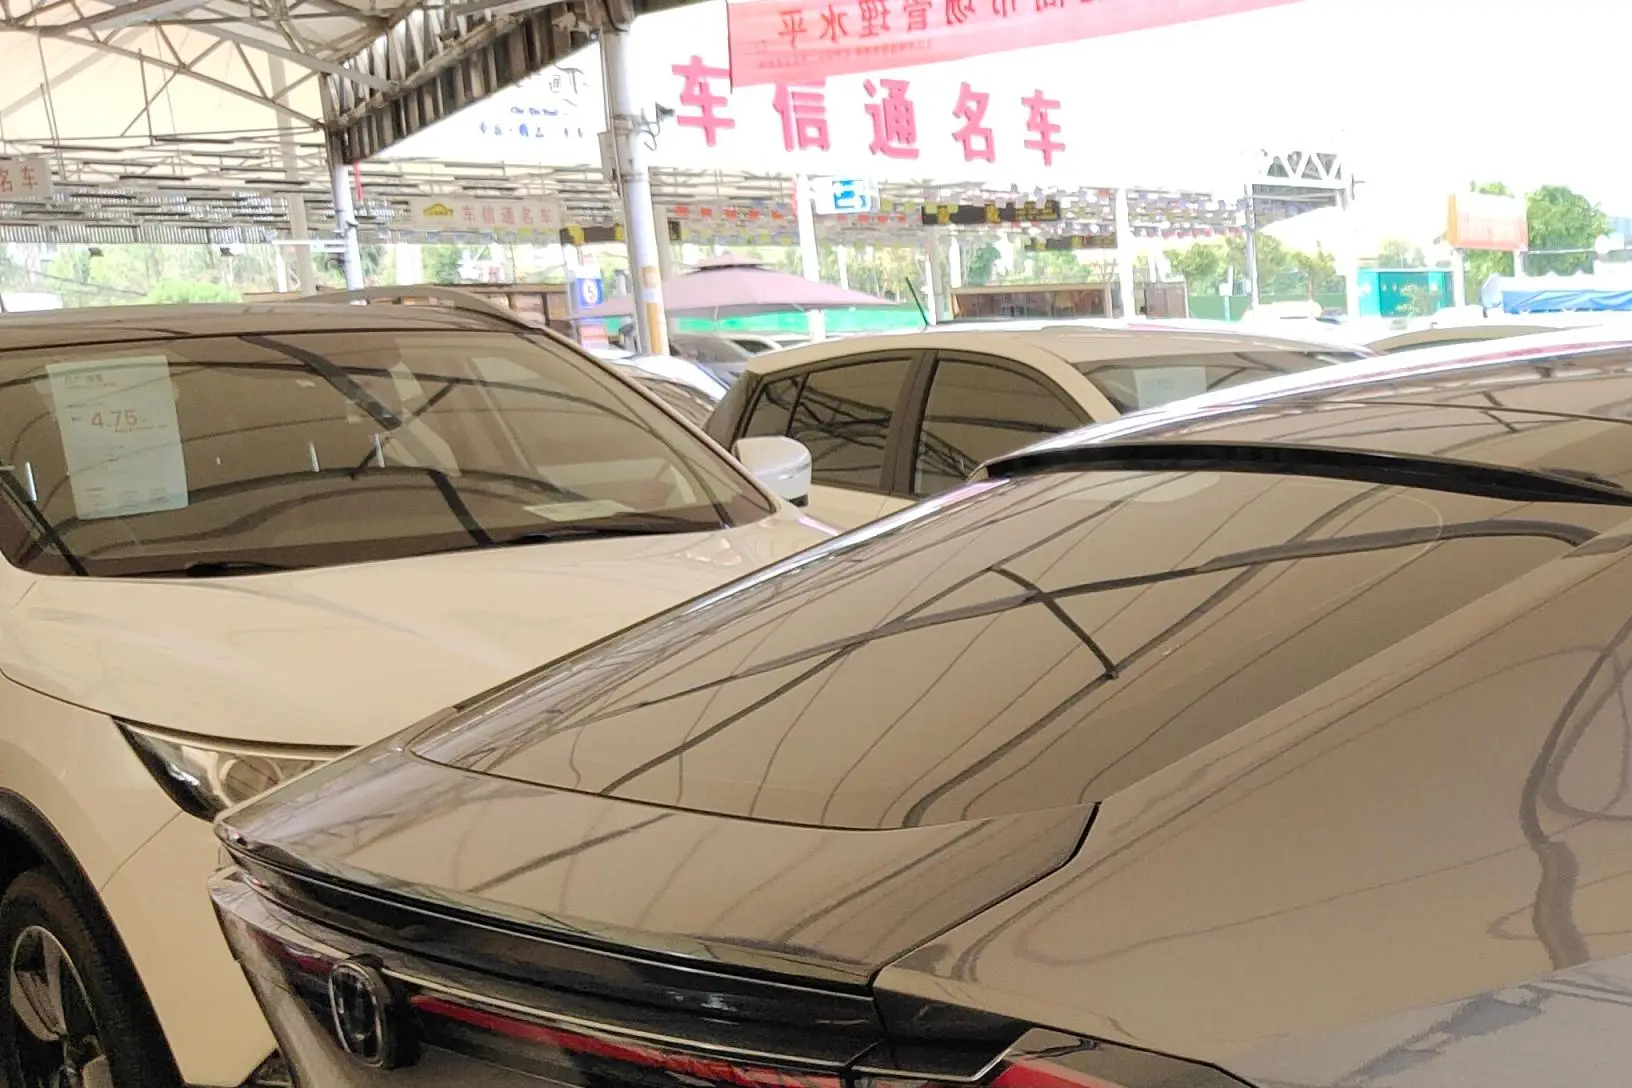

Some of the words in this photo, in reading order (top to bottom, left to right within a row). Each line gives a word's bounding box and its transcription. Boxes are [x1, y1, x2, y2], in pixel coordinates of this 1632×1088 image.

[671, 54, 1067, 167] 车信通名车
[90, 408, 138, 430] 4.75
